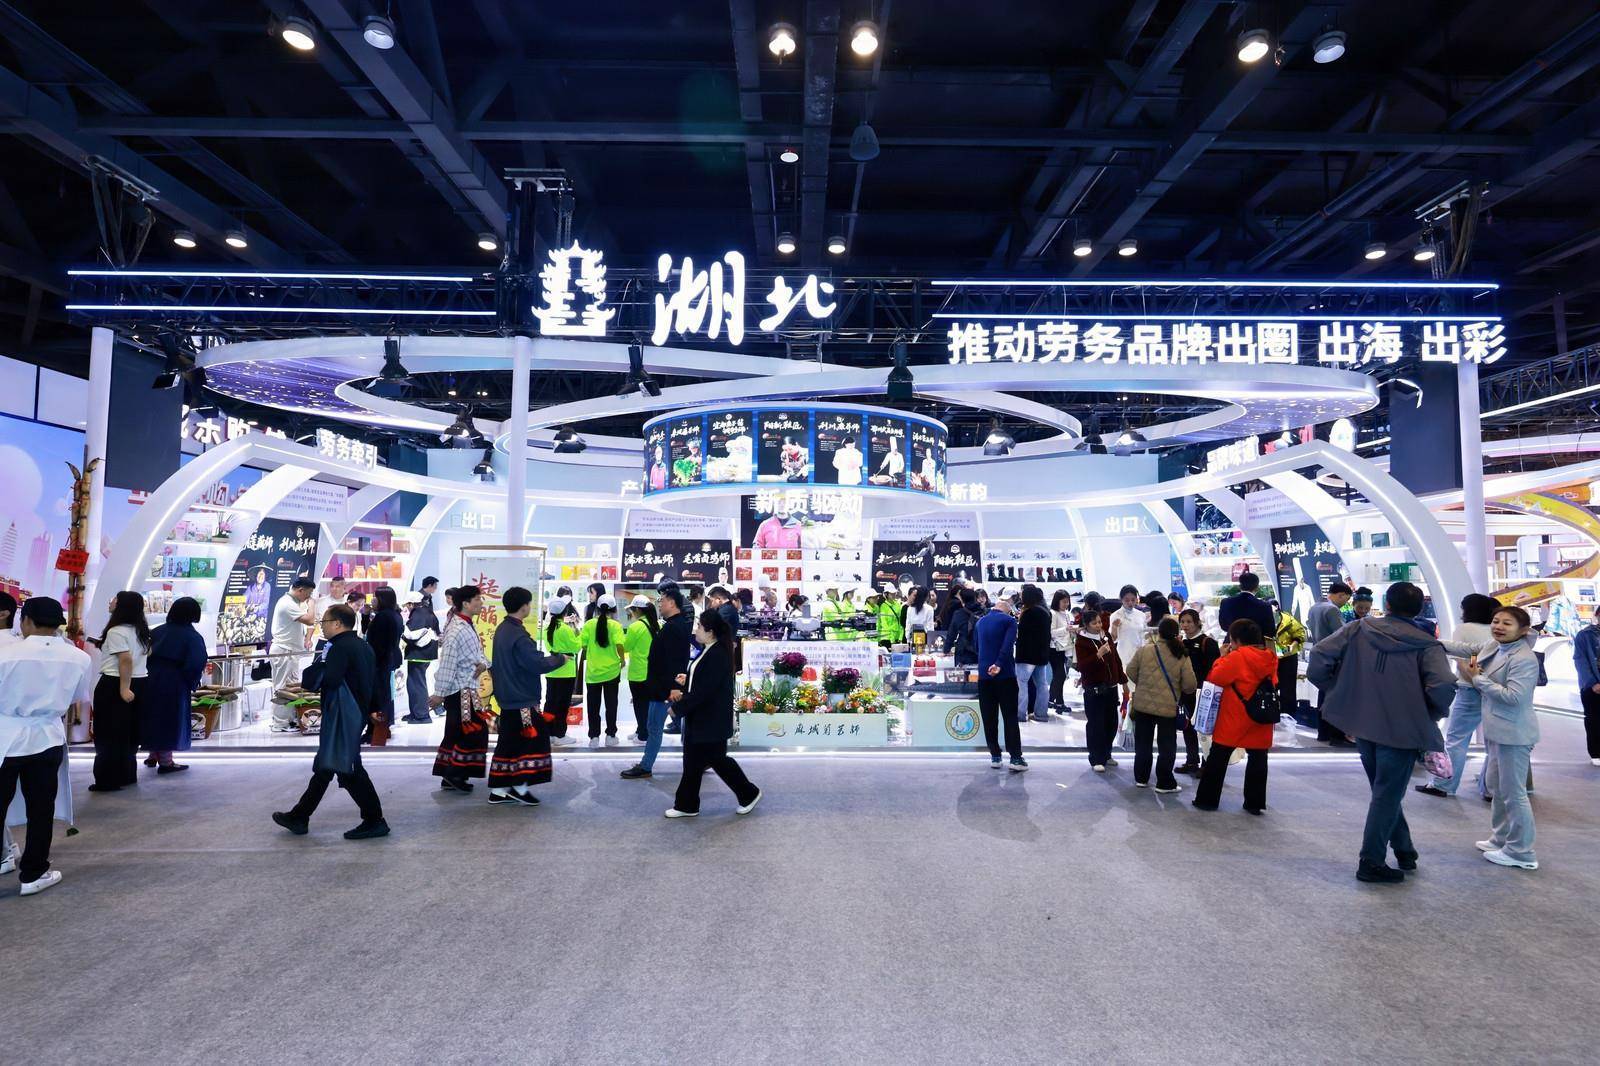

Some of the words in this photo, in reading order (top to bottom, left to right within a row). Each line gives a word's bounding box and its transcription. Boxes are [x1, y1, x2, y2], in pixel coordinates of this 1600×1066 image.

[651, 250, 837, 346] 湖北
[947, 322, 1299, 365] 推动劳务品牌出圈
[1317, 322, 1403, 365] 出海
[1421, 322, 1508, 365] 出彩
[754, 488, 863, 515] 新质驱动
[461, 512, 496, 529] 出口
[1104, 516, 1139, 533] 出口
